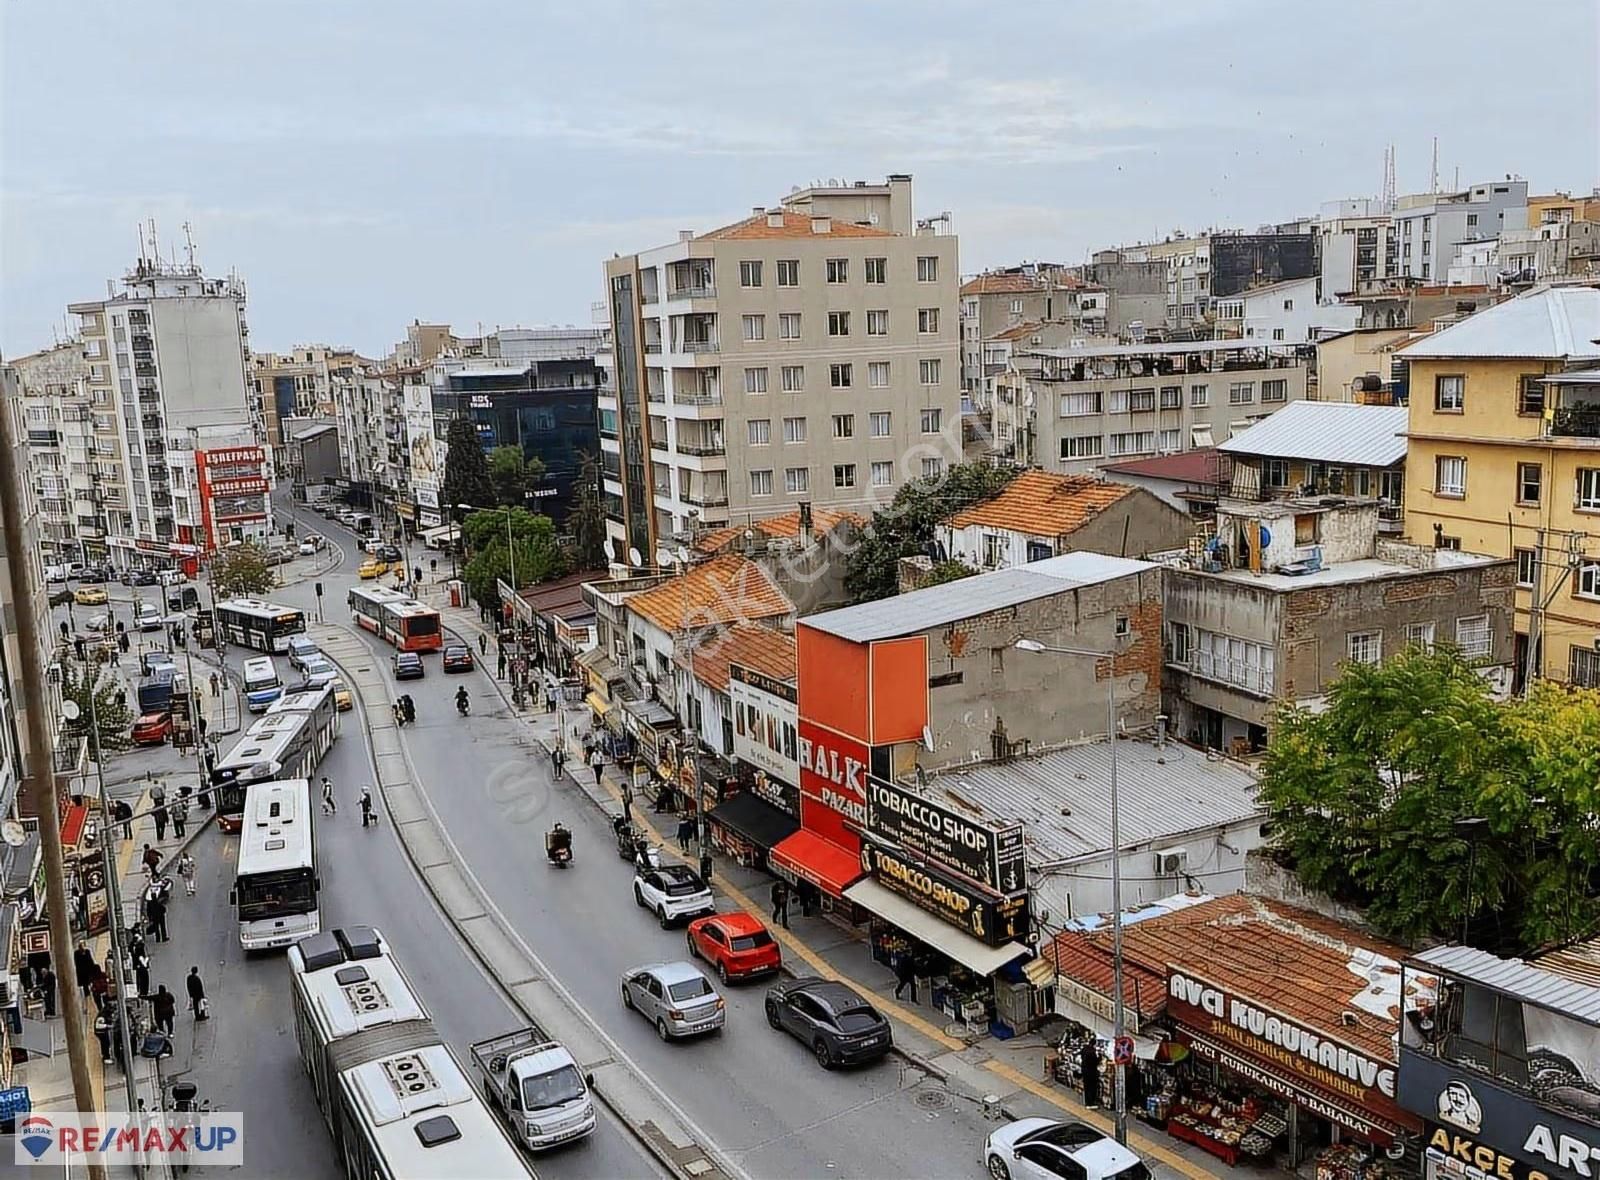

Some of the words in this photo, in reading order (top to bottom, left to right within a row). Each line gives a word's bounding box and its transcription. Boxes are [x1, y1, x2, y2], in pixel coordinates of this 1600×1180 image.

[870, 783, 941, 832] TOBACCO
[943, 817, 987, 852] SHOP
[874, 850, 933, 895] TOBACCO
[932, 882, 970, 914] SHOP
[1170, 974, 1224, 1018] AVCI
[1230, 1000, 1395, 1098] KURUKAHVE
[1189, 1040, 1216, 1060] AVCI
[1220, 1053, 1294, 1098] KURUKAHVE
[1308, 1096, 1372, 1136] BAHARAT
[1430, 1128, 1515, 1180] AKÇE
